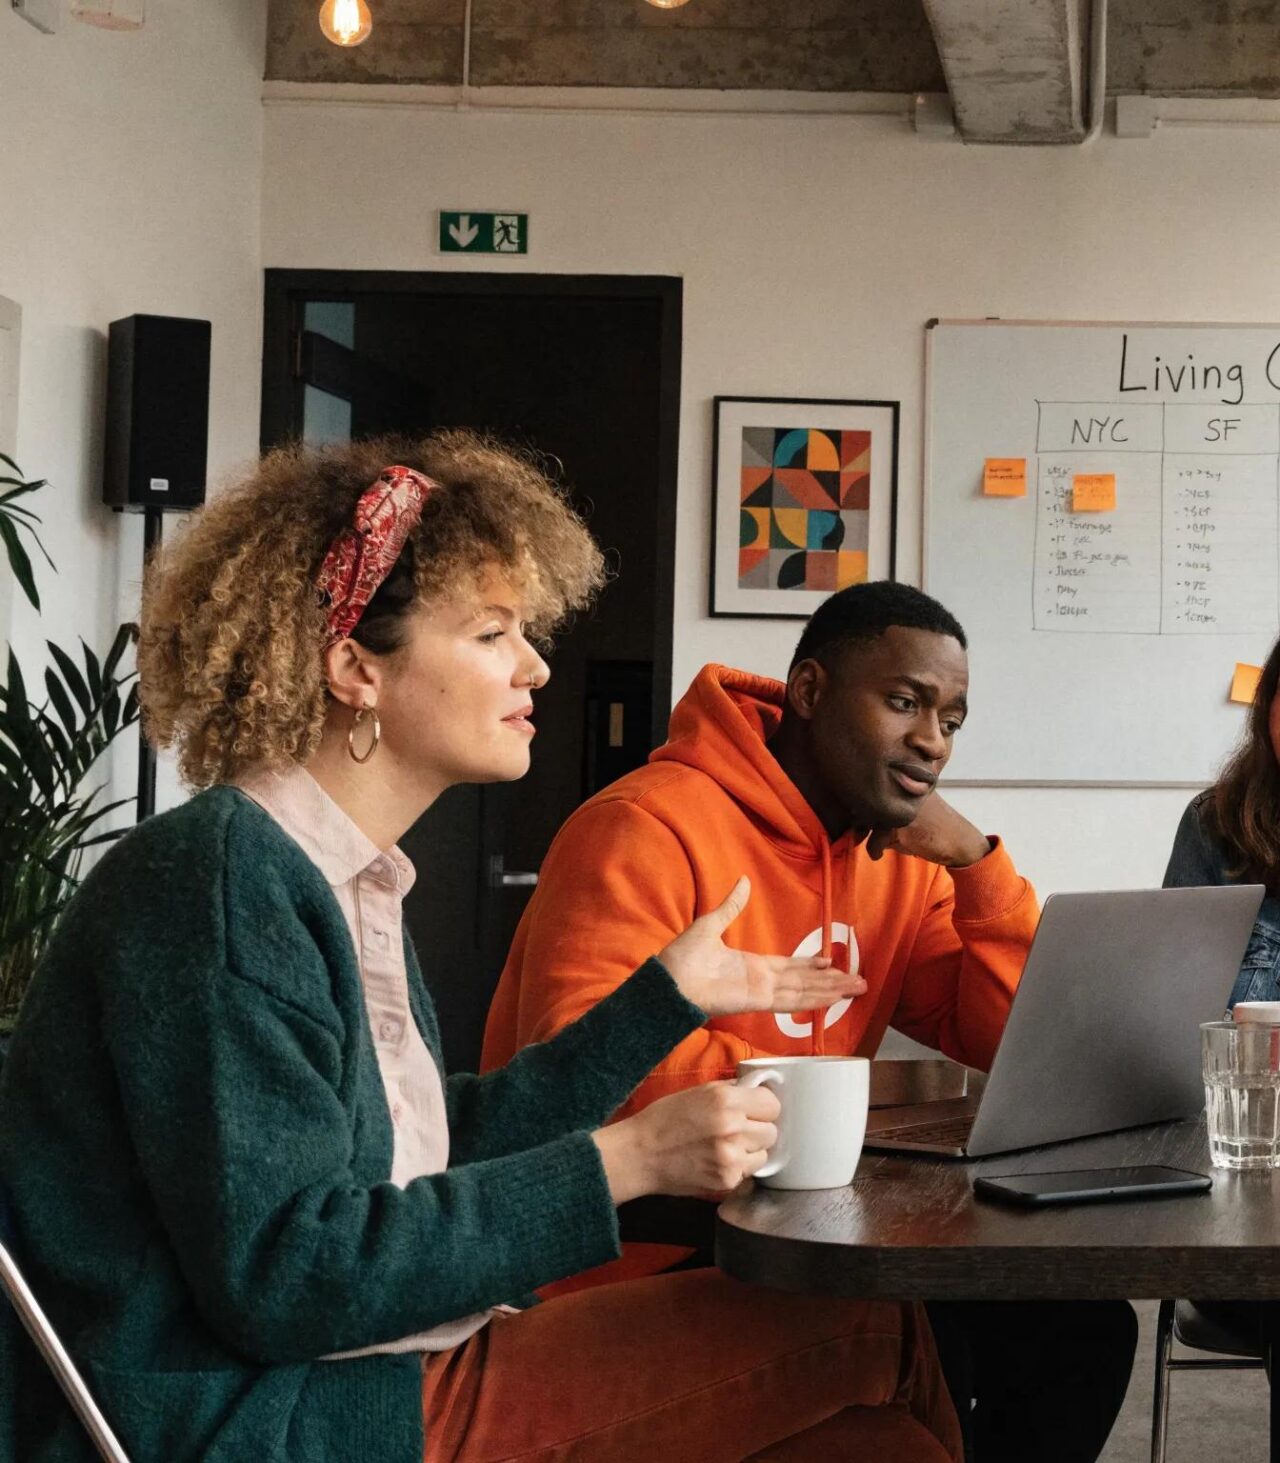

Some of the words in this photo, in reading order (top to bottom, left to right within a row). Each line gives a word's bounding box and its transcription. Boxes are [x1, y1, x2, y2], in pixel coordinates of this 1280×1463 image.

[1119, 334, 1244, 405] Living
[1071, 416, 1129, 444] NYC
[1204, 418, 1241, 441] SF
